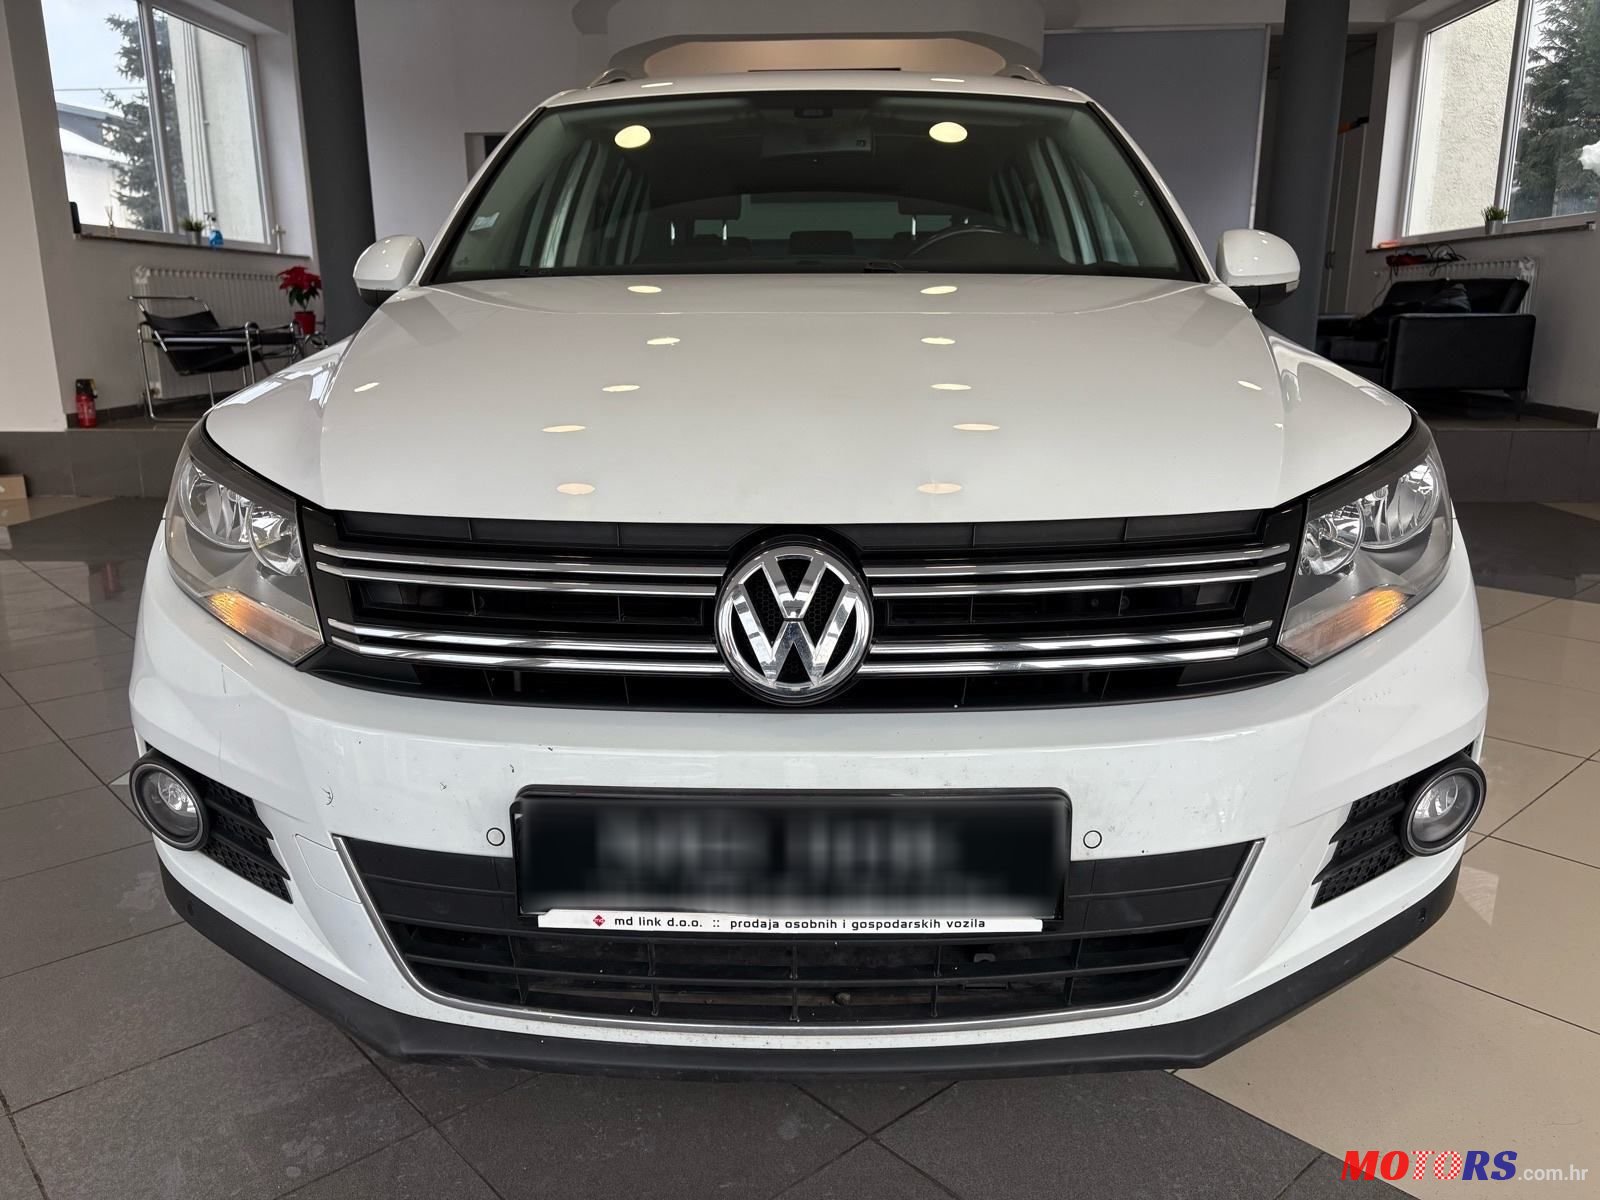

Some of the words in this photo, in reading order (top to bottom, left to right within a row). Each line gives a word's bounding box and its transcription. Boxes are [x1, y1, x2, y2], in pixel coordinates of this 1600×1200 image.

[614, 916, 633, 926] md
[638, 916, 662, 927] link
[667, 917, 703, 928] d.o.o.
[730, 918, 780, 931] prodaja
[785, 919, 837, 929] osobnih
[842, 919, 846, 929] i
[852, 919, 941, 931] gospodarskih
[946, 918, 985, 929] vozila
